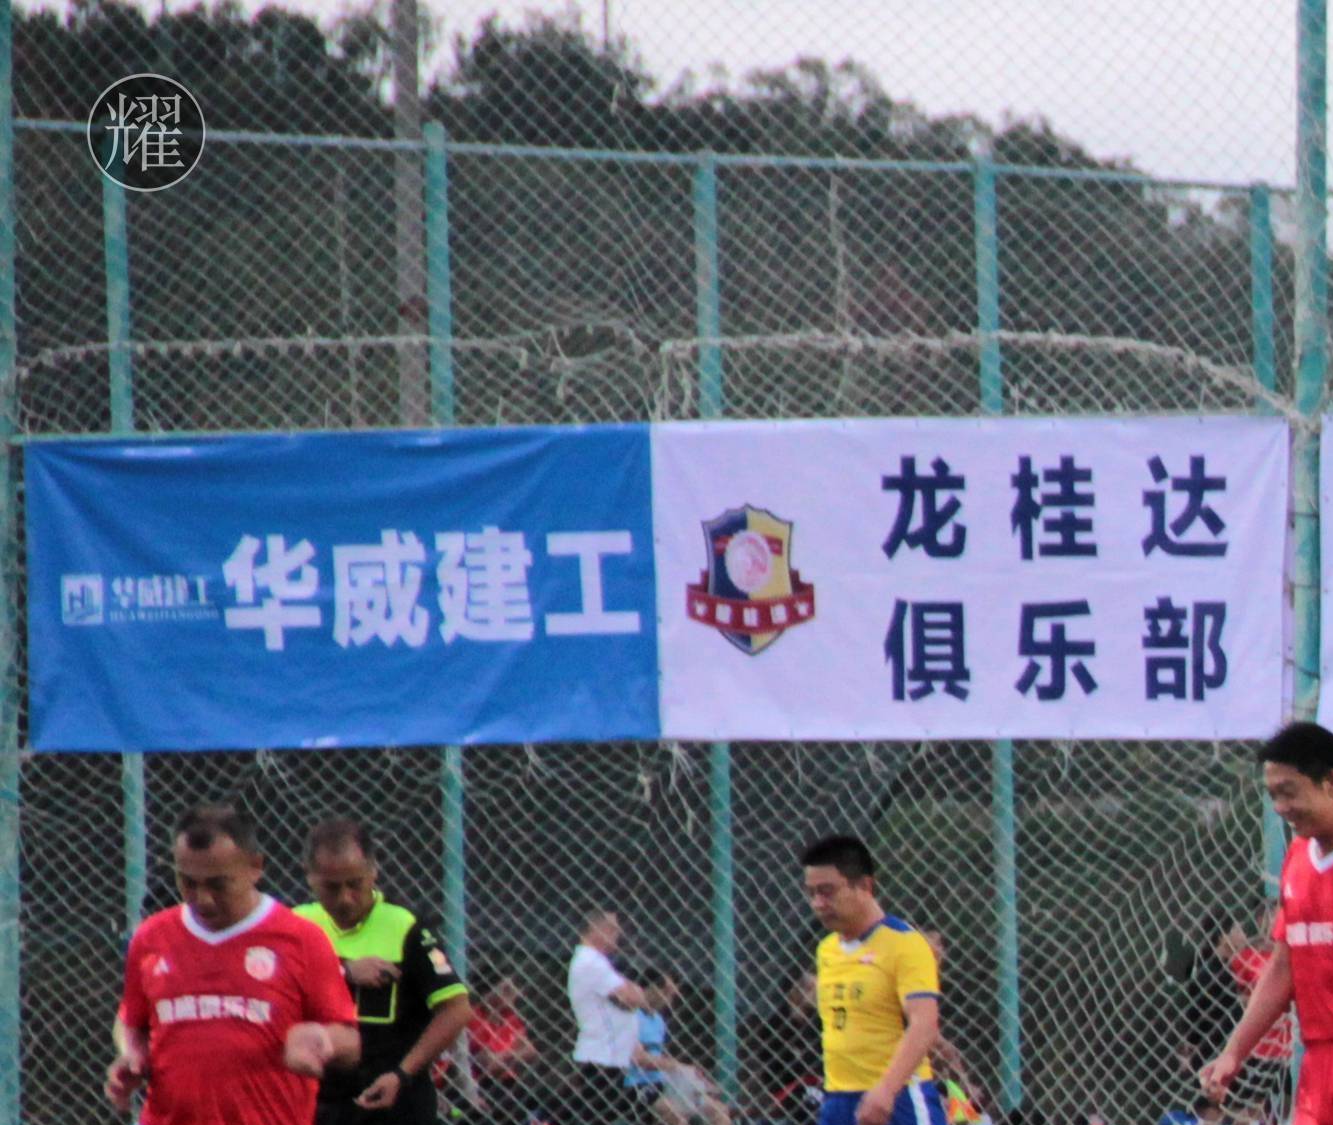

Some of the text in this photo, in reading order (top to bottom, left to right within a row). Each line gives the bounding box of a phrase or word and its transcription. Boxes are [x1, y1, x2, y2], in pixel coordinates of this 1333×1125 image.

[882, 455, 1229, 560] 龙桂达
[222, 527, 641, 651] 华威建工
[884, 597, 1228, 702] 俱乐部
